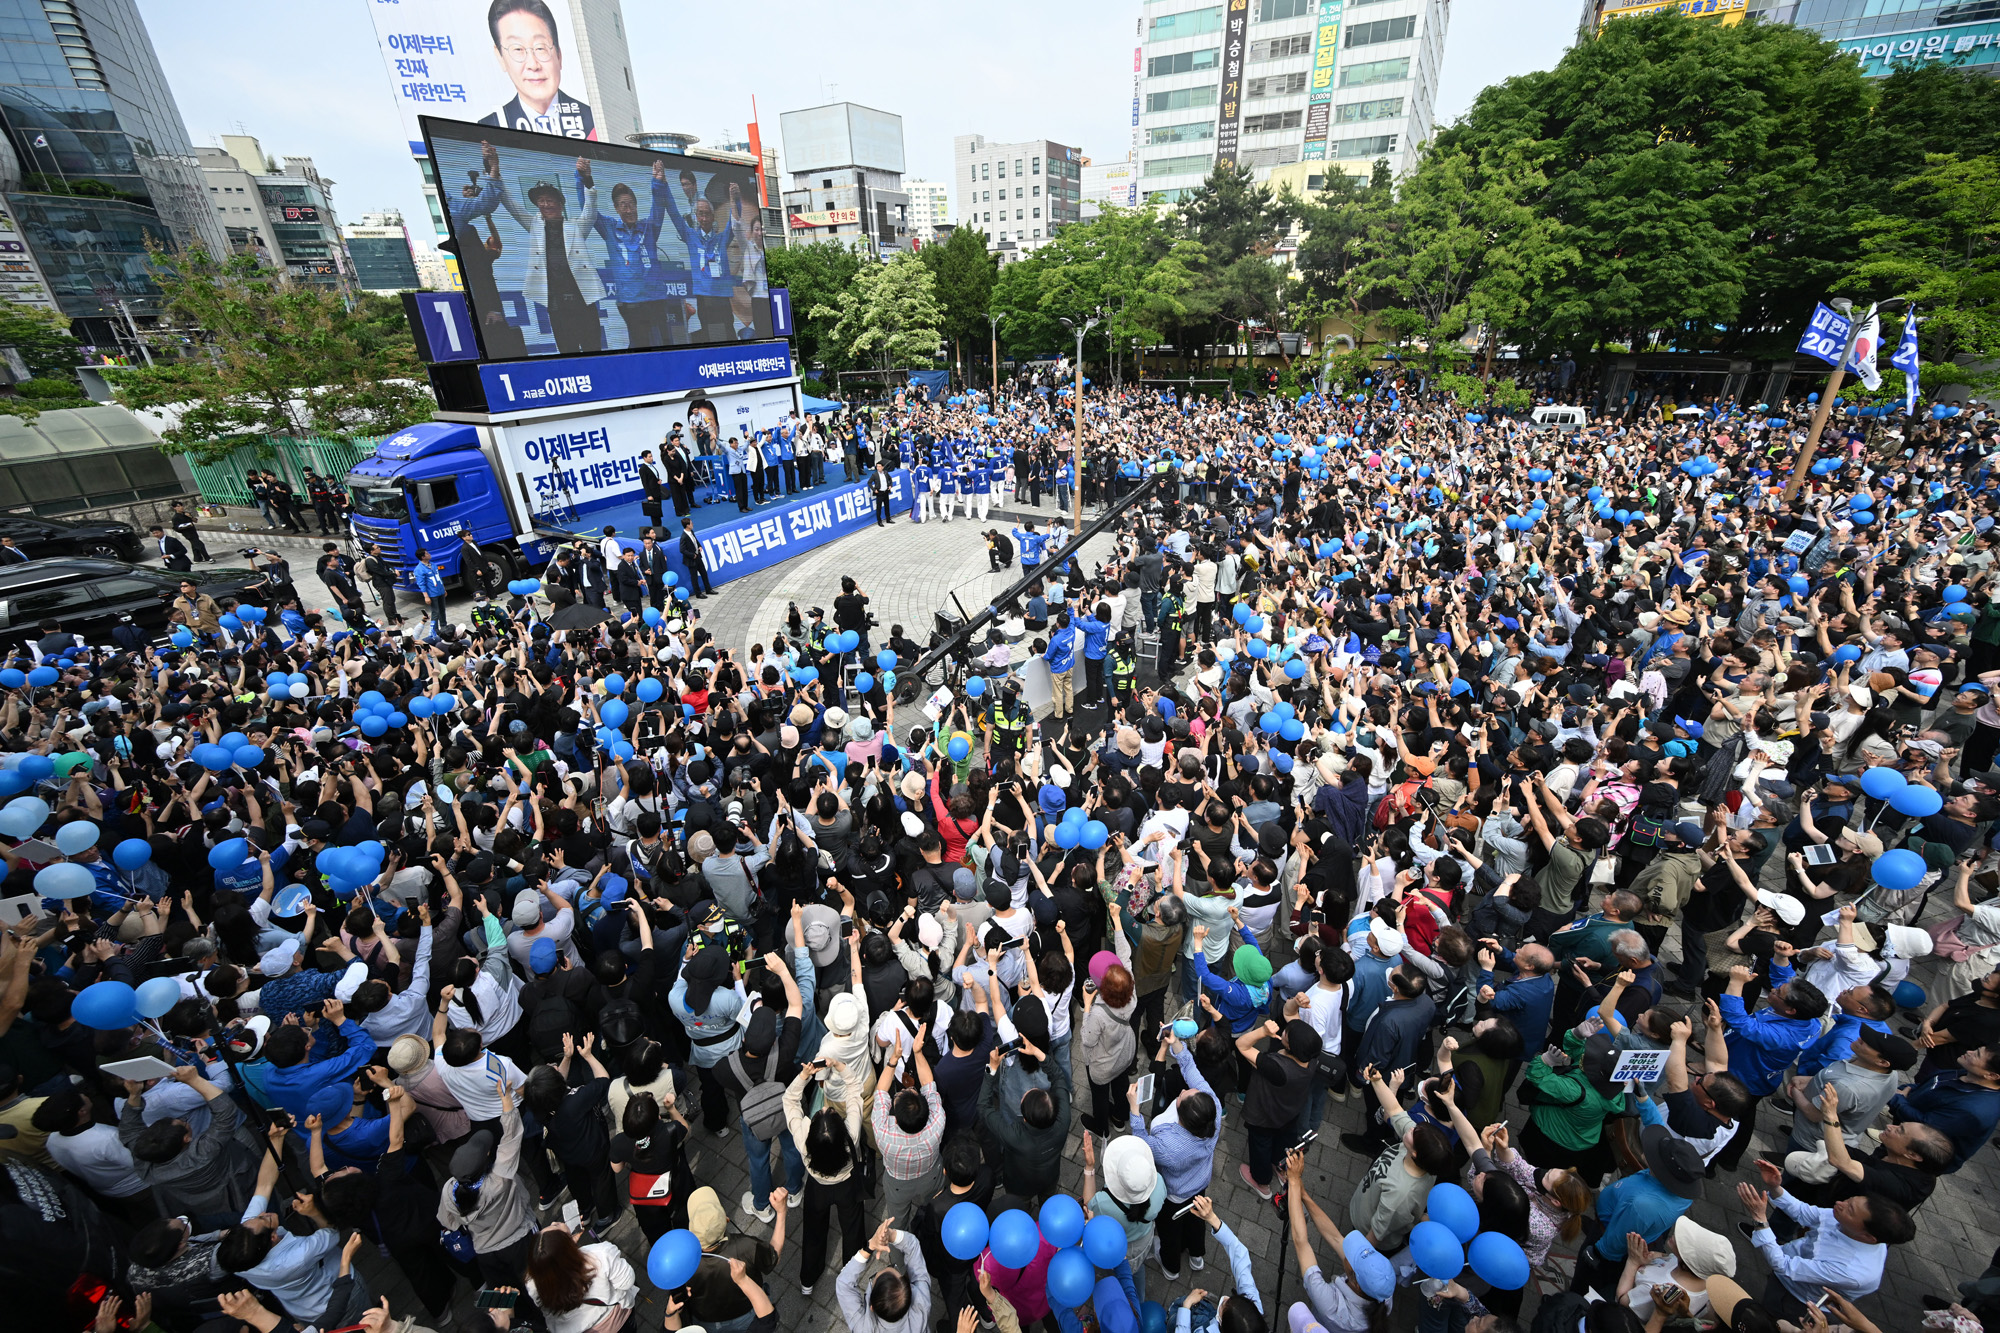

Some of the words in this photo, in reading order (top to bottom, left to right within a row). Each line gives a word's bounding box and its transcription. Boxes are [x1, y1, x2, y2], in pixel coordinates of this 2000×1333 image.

[388, 34, 455, 55] 이제부터
[1228, 18, 1244, 78] 박승철
[1313, 24, 1338, 88] 찜질방
[394, 58, 430, 78] 진짜
[402, 82, 467, 102] 대한민국
[1224, 81, 1238, 118] 가발
[552, 102, 580, 114] 지금은
[1345, 101, 1393, 116] 하이모
[516, 116, 586, 140] 이재명
[830, 210, 856, 223] 한의원
[774, 294, 785, 330] 1
[1812, 308, 1850, 340] 대한
[434, 301, 462, 352] 1
[698, 362, 736, 378] 이제부터
[737, 360, 753, 374] 진짜
[754, 356, 785, 373] 대한민국
[499, 374, 516, 402] 1
[522, 388, 546, 400] 지금은
[545, 374, 592, 396] 이재명
[736, 406, 750, 415] 민주당
[524, 427, 610, 464] 이제부터
[534, 471, 579, 500] 진짜
[419, 528, 429, 542] 1
[432, 525, 462, 540] 이재명
[697, 514, 786, 578] 이제부터
[788, 499, 832, 541] 진짜
[835, 476, 902, 523] 대한국
[1614, 1070, 1658, 1080] 이재명
